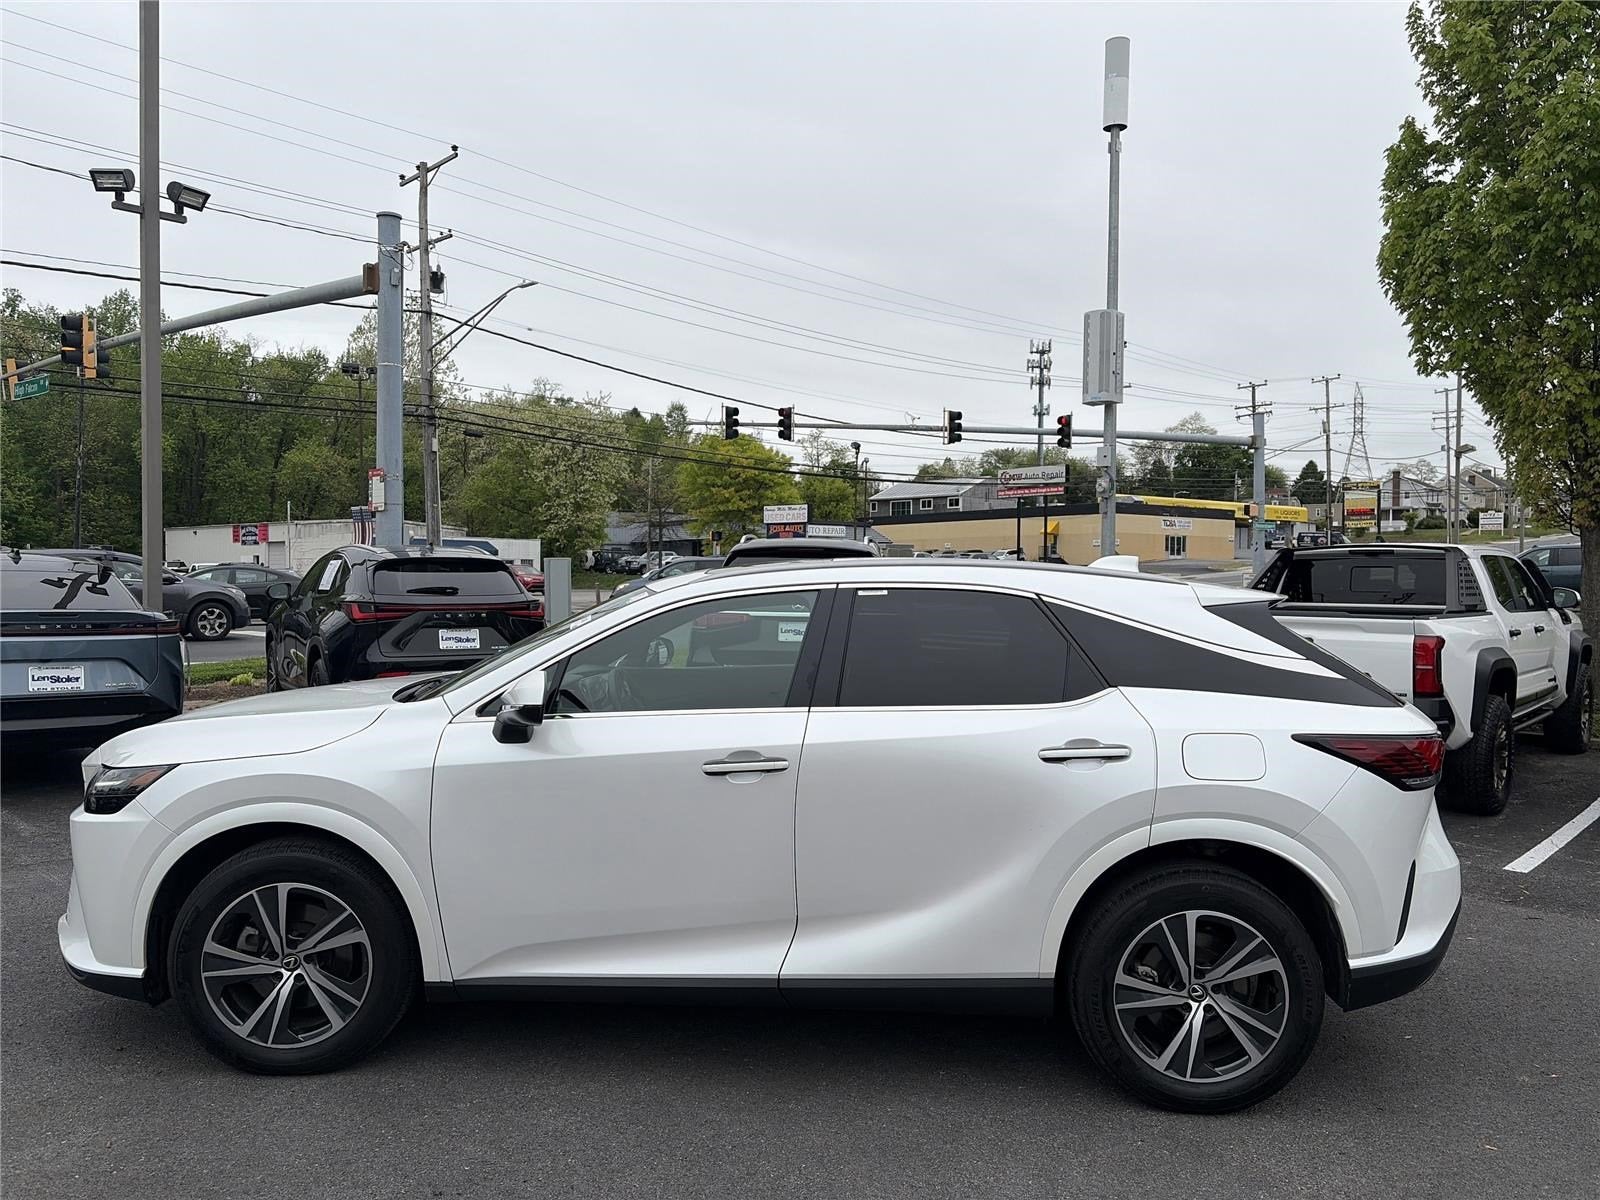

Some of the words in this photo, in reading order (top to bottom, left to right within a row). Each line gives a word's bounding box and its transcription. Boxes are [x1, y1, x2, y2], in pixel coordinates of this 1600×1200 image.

[1023, 472, 1040, 480] Auto
[1041, 470, 1064, 481] Repair
[765, 513, 785, 522] USED
[785, 512, 806, 521] CARS
[822, 527, 846, 535] REPAIR
[780, 627, 805, 636] LenSto
